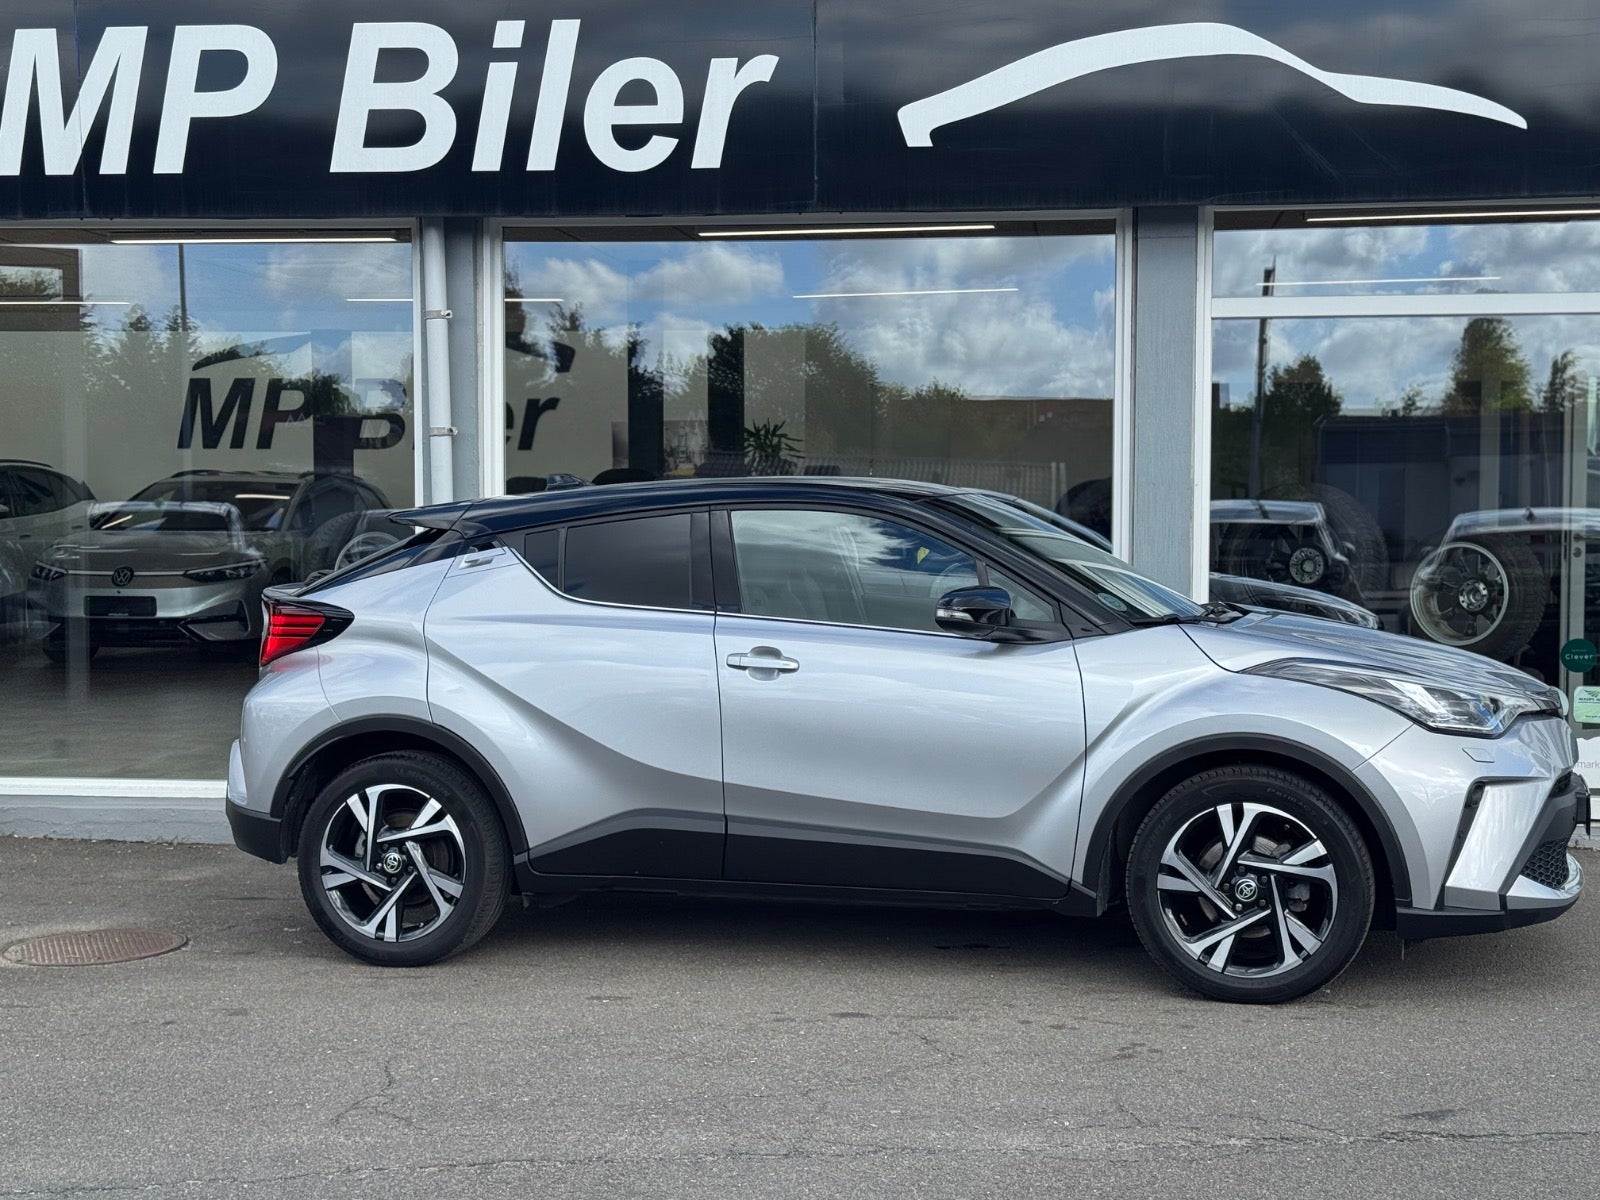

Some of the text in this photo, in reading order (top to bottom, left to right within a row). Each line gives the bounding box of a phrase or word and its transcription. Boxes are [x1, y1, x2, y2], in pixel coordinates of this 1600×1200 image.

[0, 18, 779, 176] MP Biler
[177, 377, 312, 450] MP
